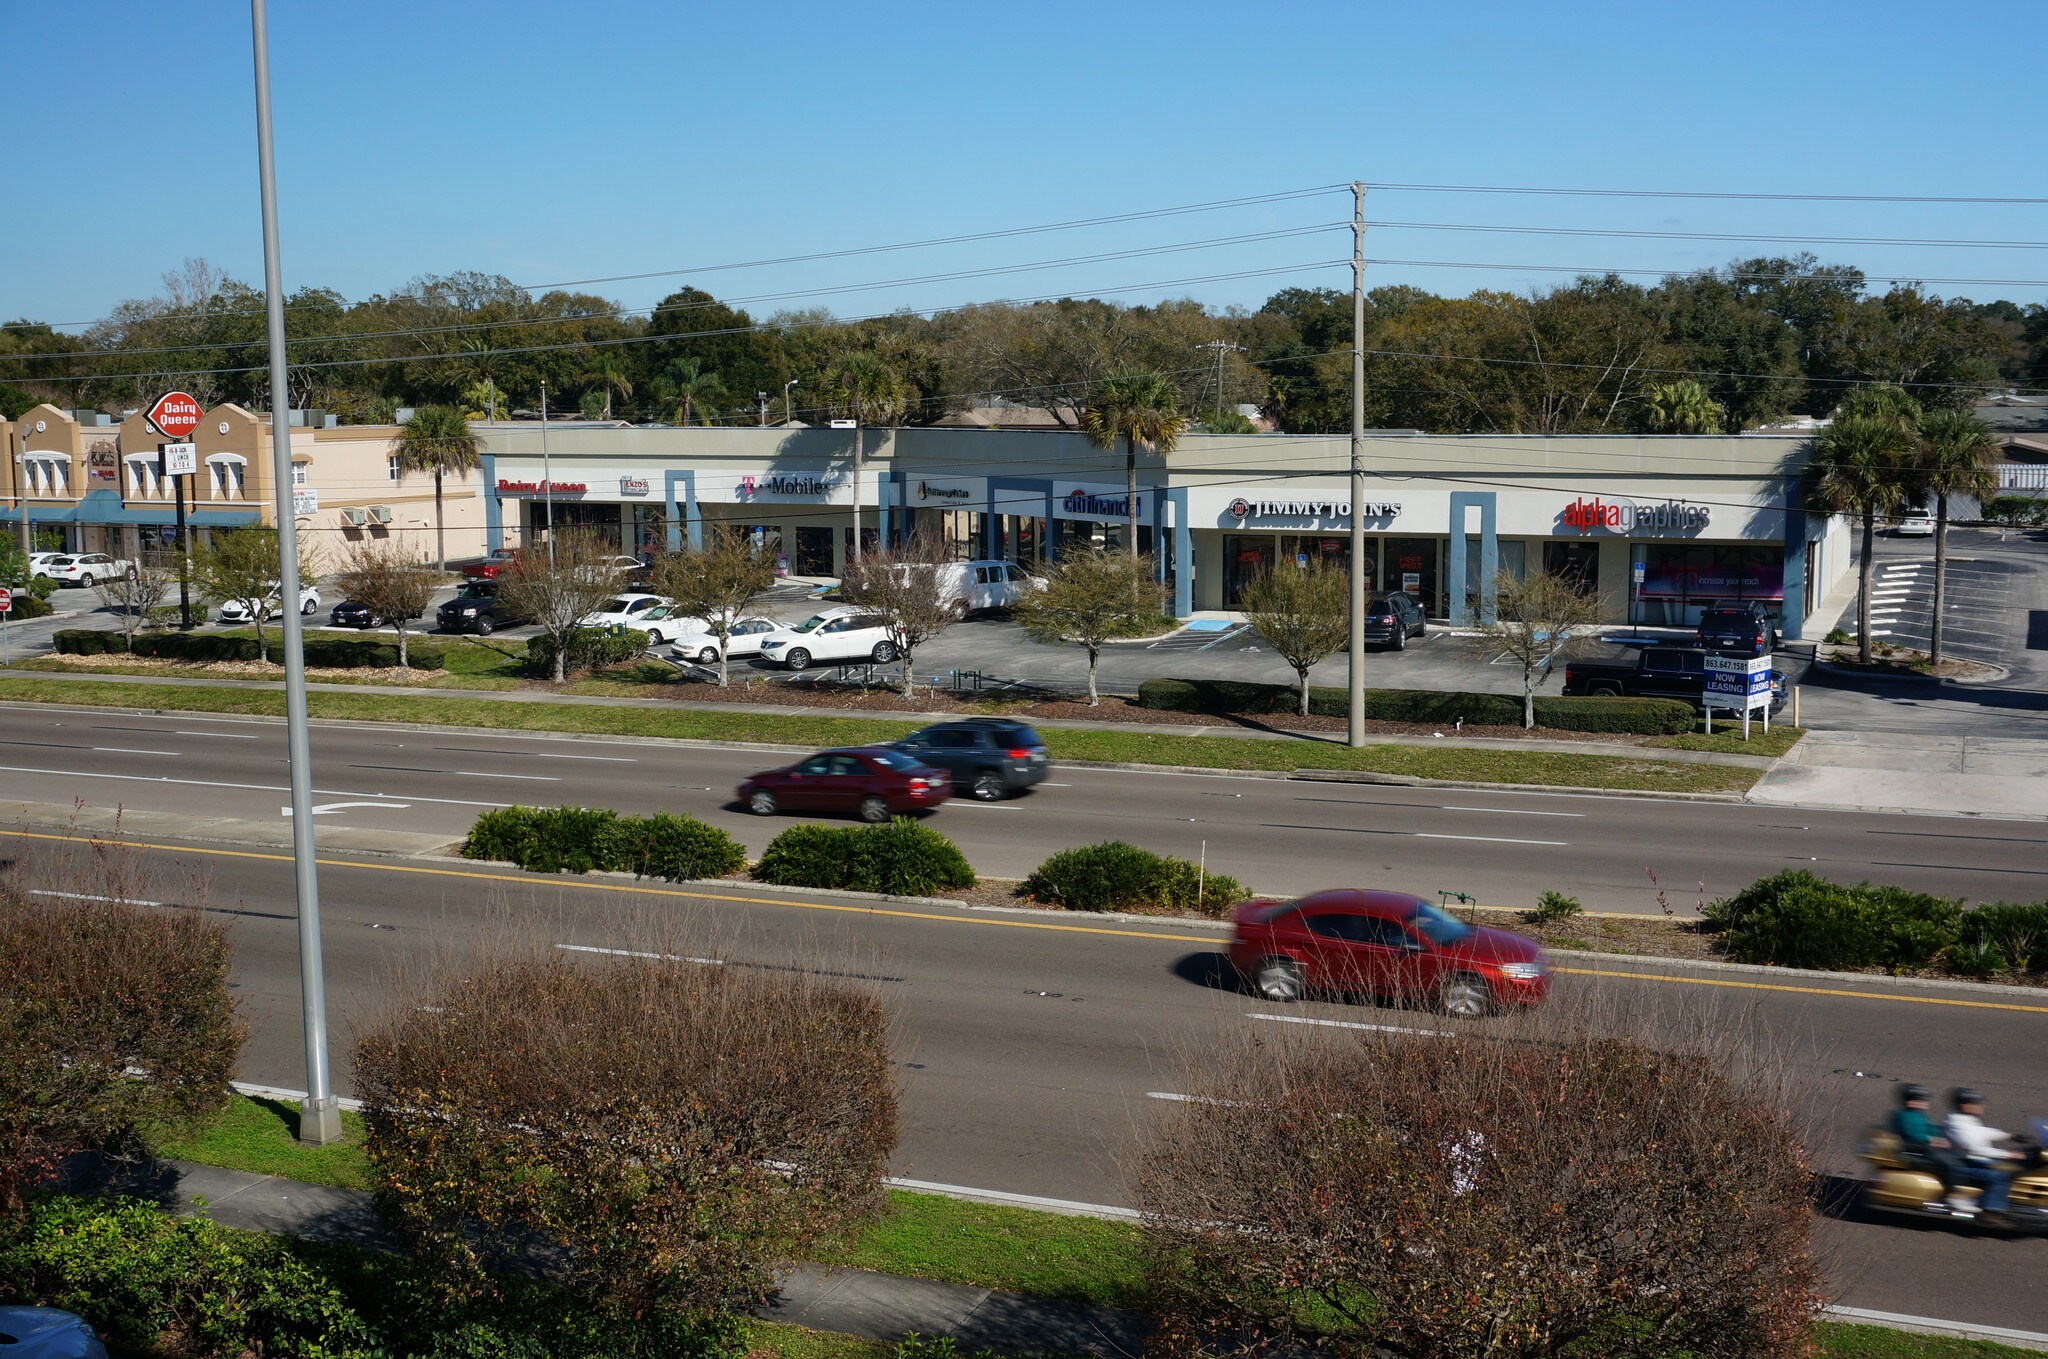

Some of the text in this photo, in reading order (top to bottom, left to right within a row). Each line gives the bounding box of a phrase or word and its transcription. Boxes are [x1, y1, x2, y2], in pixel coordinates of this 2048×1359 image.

[164, 401, 196, 415] Dairy
[160, 414, 196, 427] Queen
[498, 479, 587, 493] Dairy Queen
[771, 477, 823, 494] Mobile
[1255, 500, 1325, 517] JIMMY
[1564, 497, 1710, 533] alphagraphics
[1698, 576, 1724, 585] increase
[1741, 576, 1760, 585] reach
[1705, 659, 1748, 671] 863.647.1581
[1715, 673, 1736, 683] NOW
[1754, 672, 1766, 683] NOW
[1707, 681, 1744, 693] LEASING
[1750, 681, 1769, 693] LEASING
